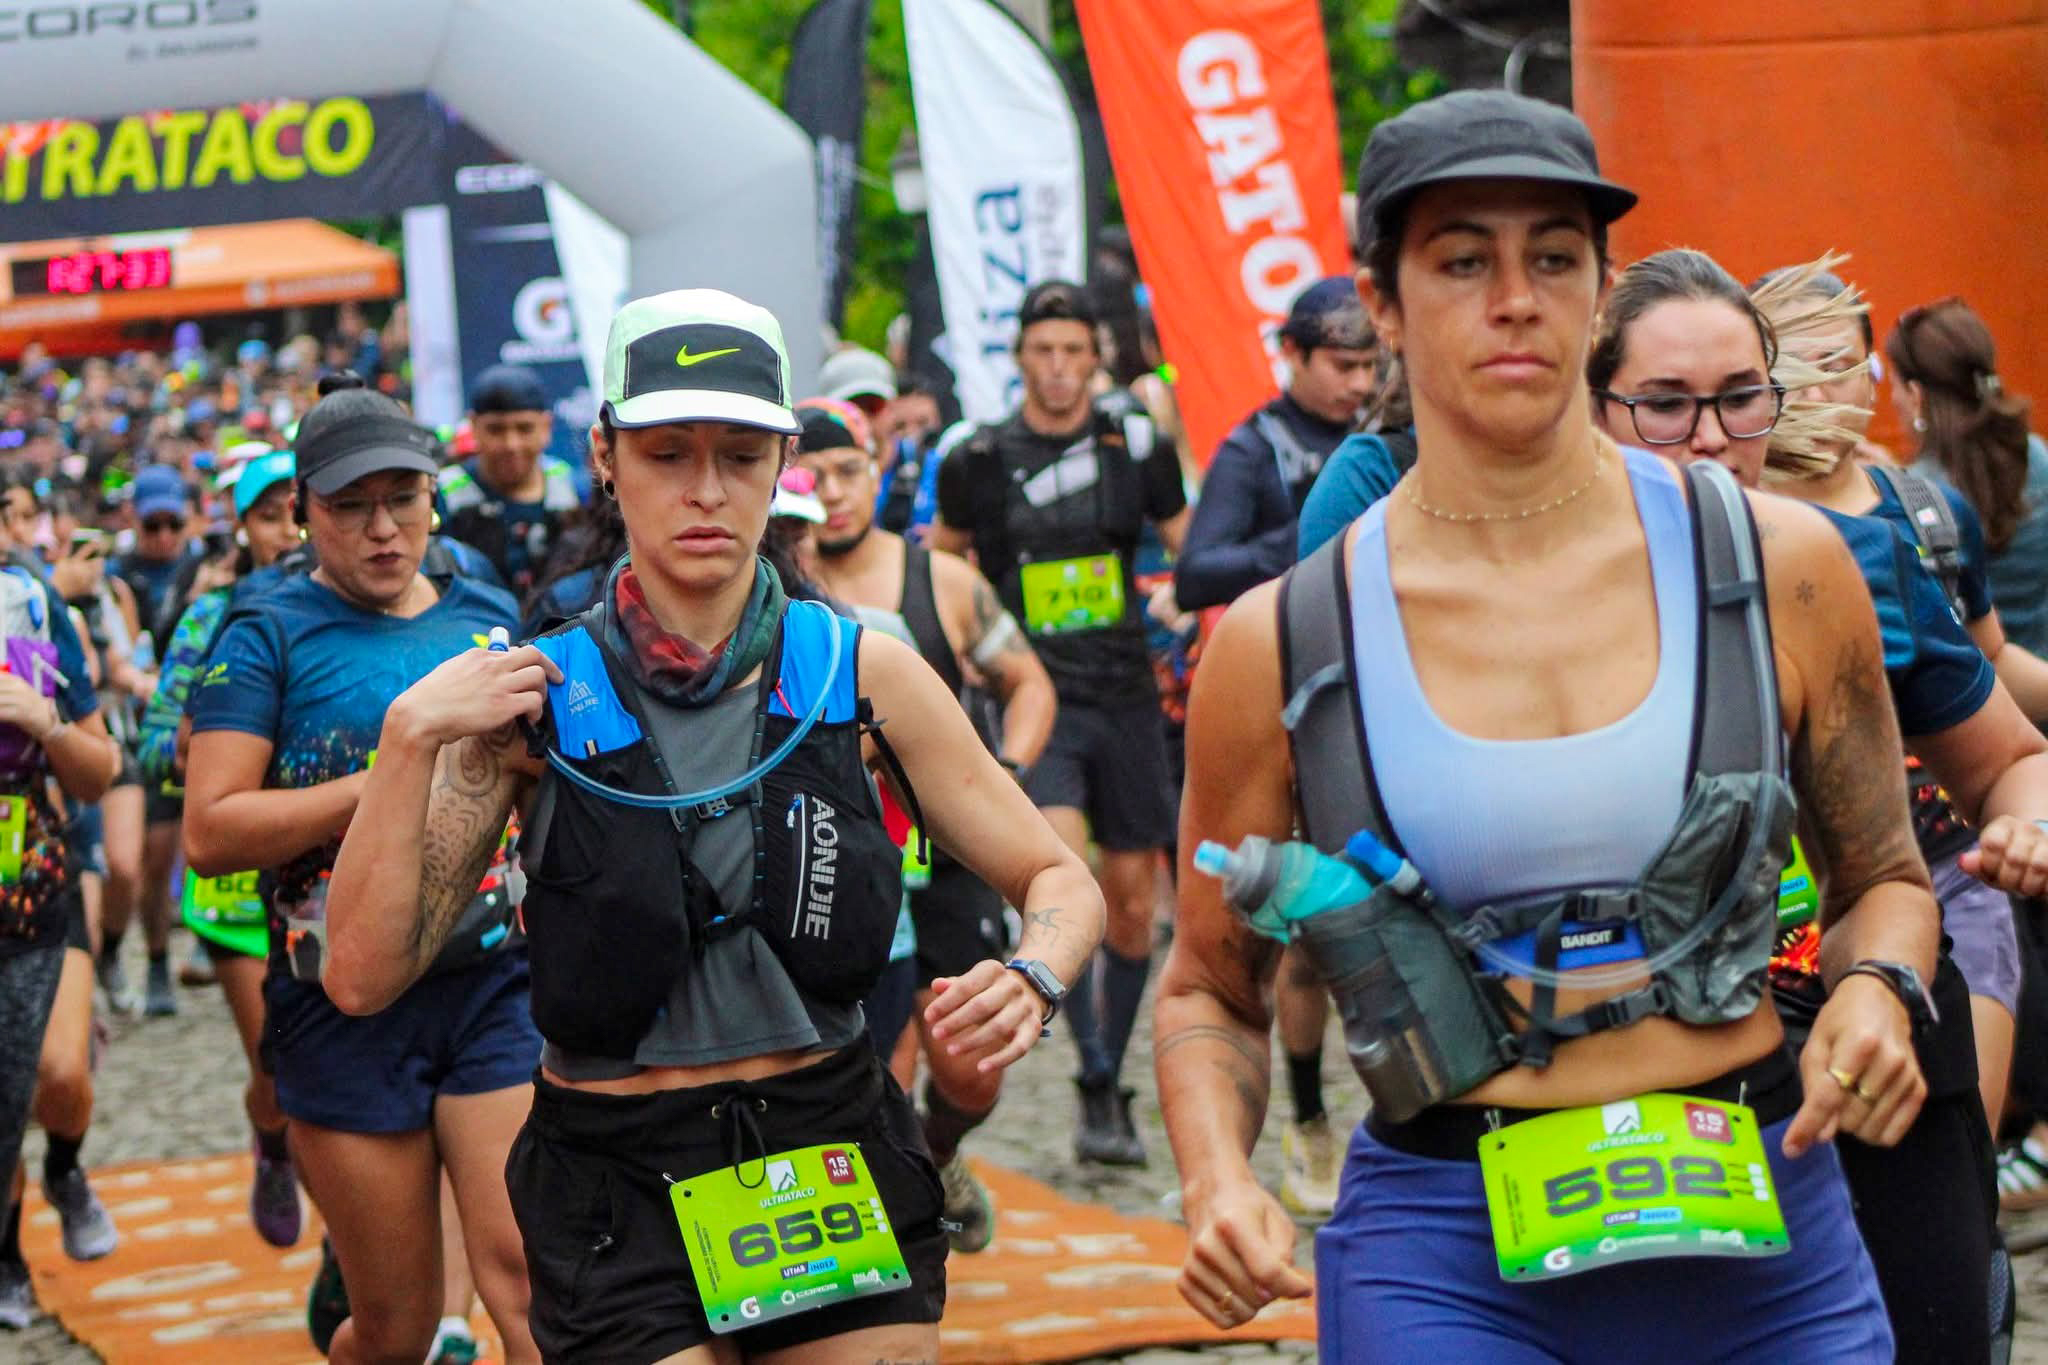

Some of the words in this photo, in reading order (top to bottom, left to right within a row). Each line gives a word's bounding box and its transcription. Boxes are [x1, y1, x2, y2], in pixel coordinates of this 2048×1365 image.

[0, 97, 375, 202] TRATACO
[805, 795, 839, 940] AONIJIE
[1560, 929, 1613, 949] BANDIT
[1692, 1110, 1724, 1127] 15
[1696, 1123, 1723, 1134] KM
[828, 1156, 849, 1169] 15
[832, 1168, 849, 1177] KM
[1544, 1156, 1732, 1218] 592
[759, 1187, 815, 1208] ULTRATACO
[728, 1202, 863, 1268] 659
[783, 1264, 806, 1278] UTMB
[810, 1260, 835, 1273] INDEX
